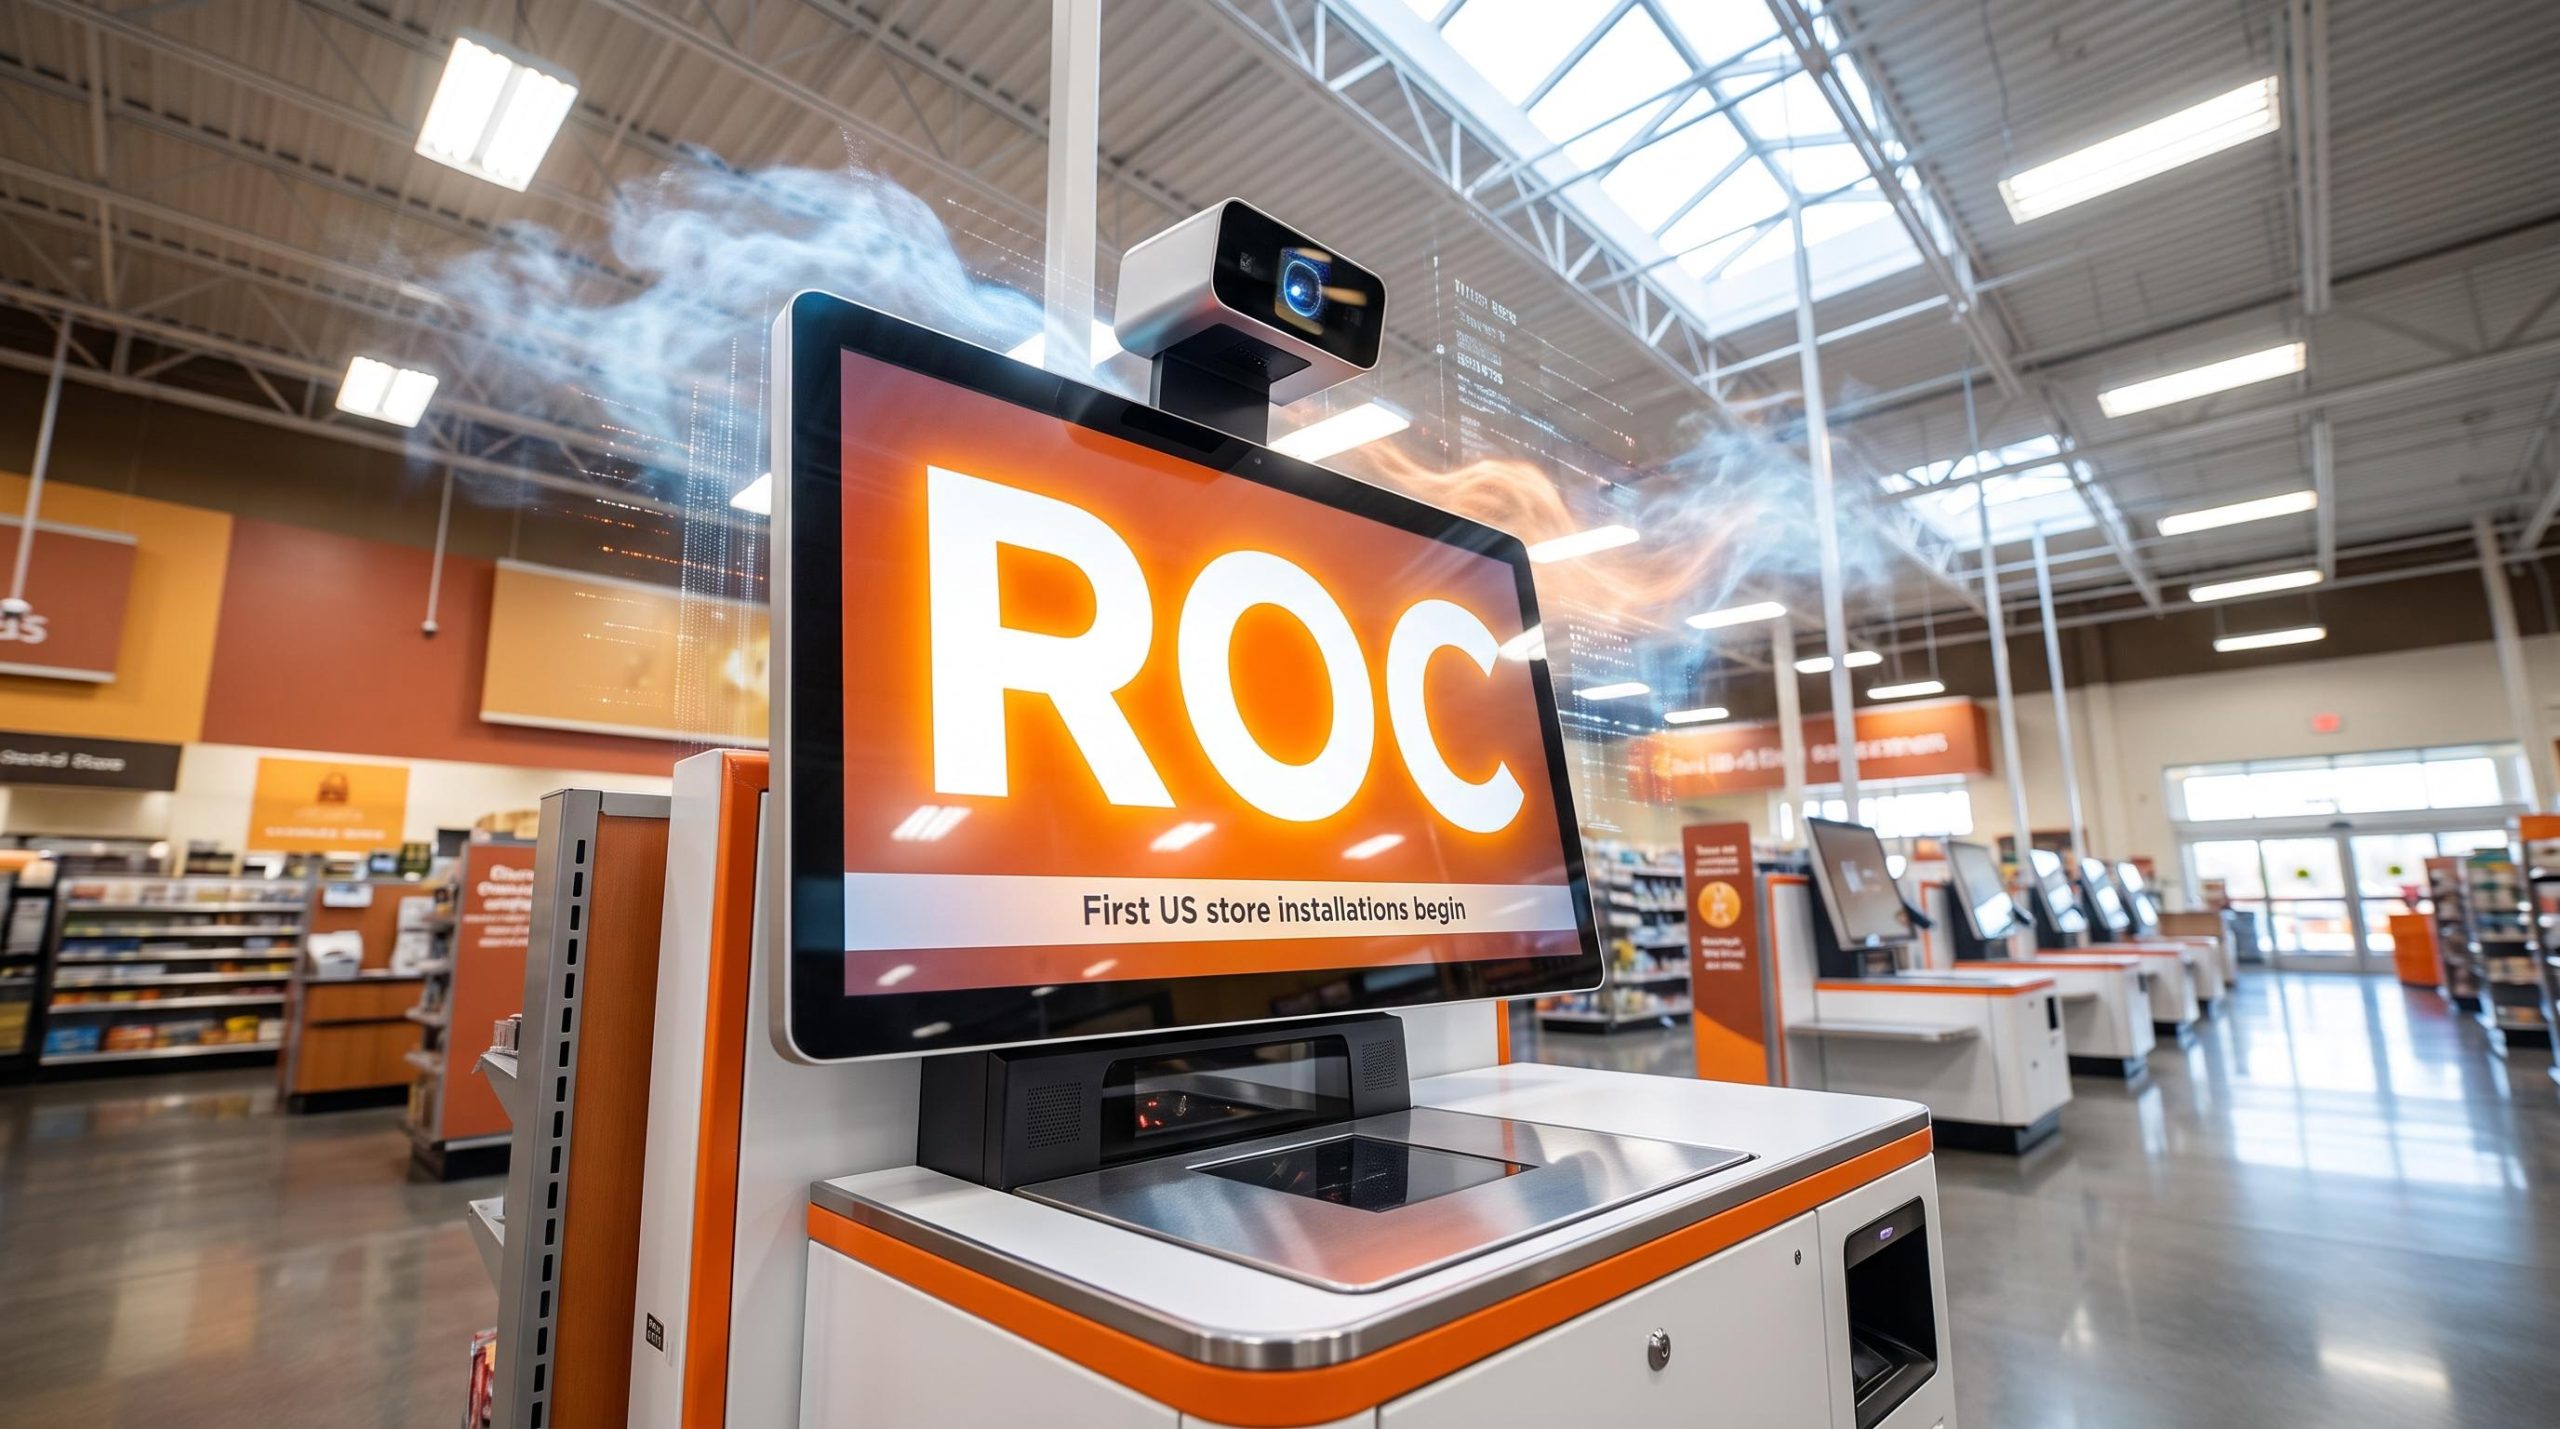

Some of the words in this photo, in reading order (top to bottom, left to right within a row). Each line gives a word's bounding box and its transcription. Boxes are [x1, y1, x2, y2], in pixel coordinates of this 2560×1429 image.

[927, 465, 1525, 833] ROC
[1083, 894, 1150, 925] First
[1160, 896, 1198, 924] US
[1207, 899, 1271, 924] store
[1278, 895, 1409, 923] installations
[1414, 896, 1467, 925] begin
